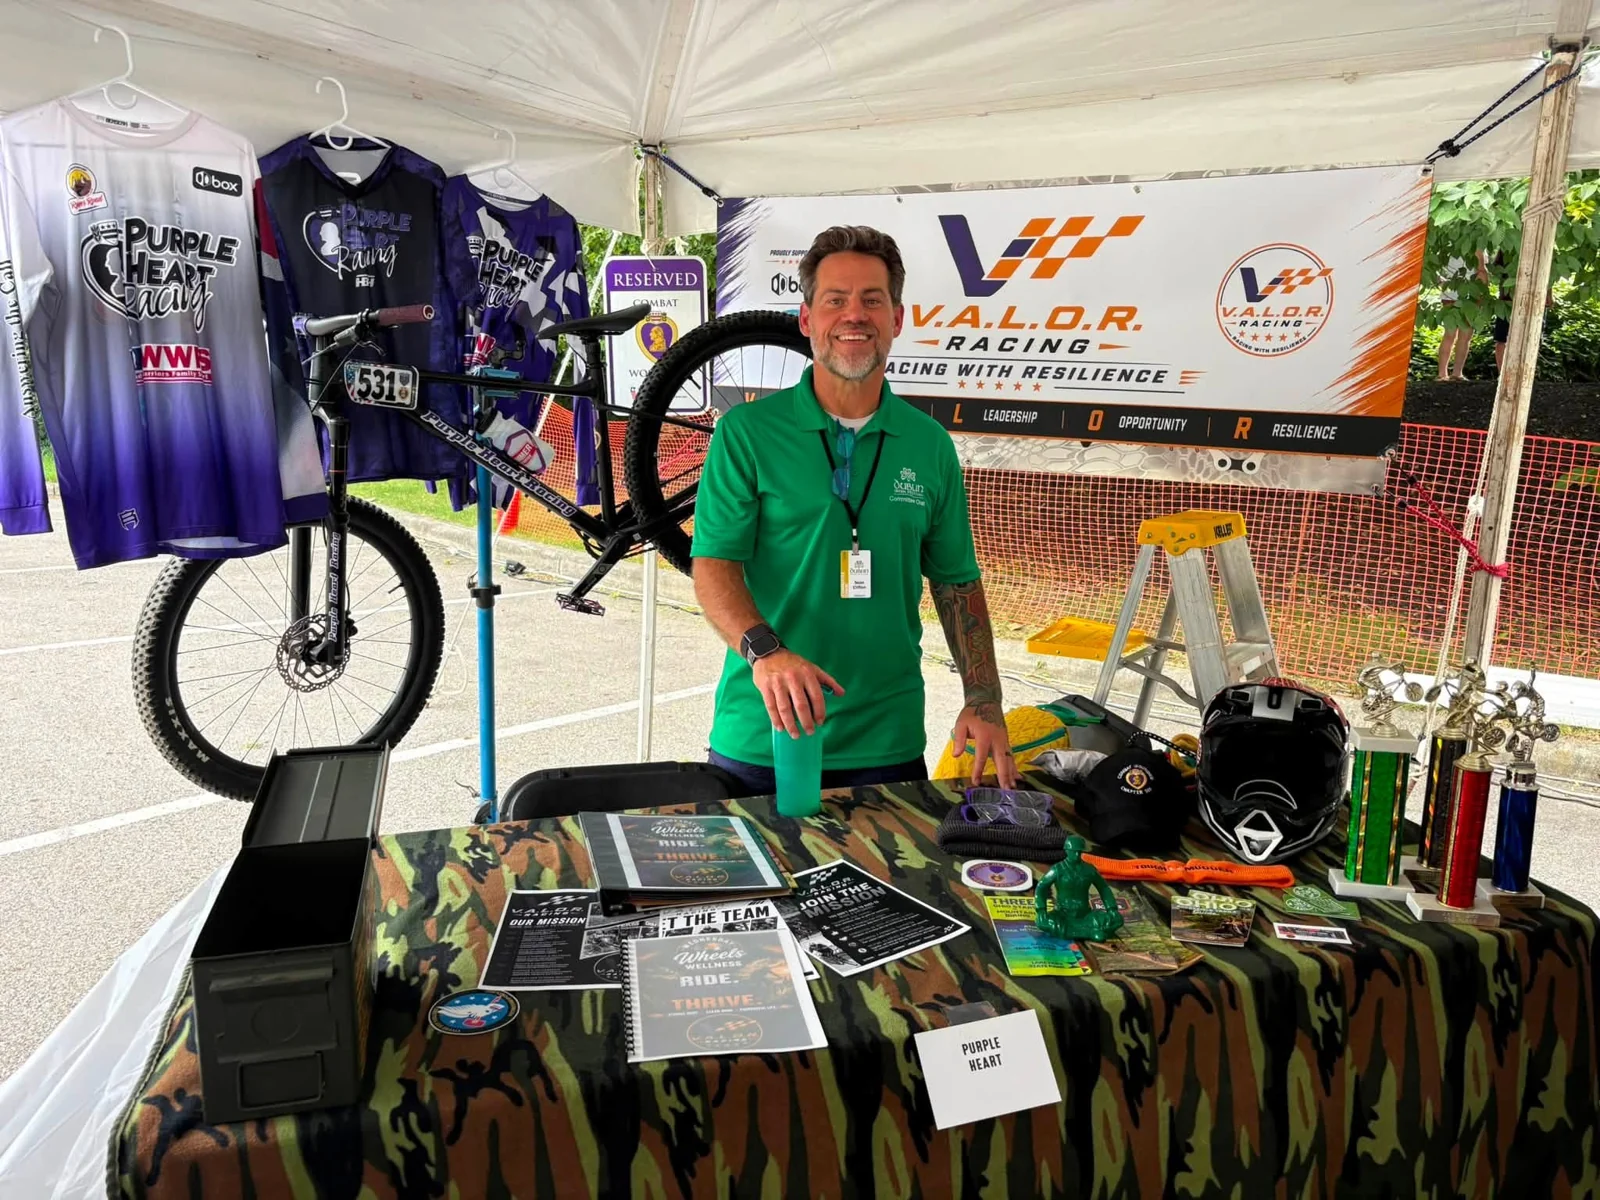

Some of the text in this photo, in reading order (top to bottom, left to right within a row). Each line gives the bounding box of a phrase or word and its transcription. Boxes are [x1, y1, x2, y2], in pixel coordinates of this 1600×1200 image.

[211, 175, 239, 192] box
[124, 217, 241, 265] PURPLE
[126, 251, 216, 289] HEART
[613, 272, 698, 287] RESERVED
[633, 299, 678, 307] COMBAT
[1222, 306, 1325, 318] V.A.L.O.R.
[912, 304, 1144, 332] V.A.L.O.R.
[1239, 320, 1303, 328] RACING
[946, 336, 1091, 355] RACING
[885, 361, 1169, 385] ACING WITH RESILIENCE
[357, 367, 396, 401] 531
[952, 403, 963, 424] L
[983, 408, 1038, 424] LEADERSHIP
[1087, 409, 1104, 431] O
[1118, 415, 1188, 432] OPPORTUNITY
[1233, 416, 1252, 440] R
[1271, 423, 1338, 440] RESILIENCE
[420, 410, 577, 516] Purple Heart Racing
[330, 531, 341, 570] Racing
[165, 696, 210, 763] MAXXIS
[650, 826, 706, 835] Wheels
[658, 839, 705, 848] RIDE.
[654, 852, 726, 861] THRIVE.
[800, 893, 836, 911] JOIN
[838, 882, 872, 896] THE
[804, 886, 887, 919] MISSION
[509, 917, 588, 926] OUR MISSION
[683, 911, 717, 927] THE
[721, 905, 770, 923] TEAM
[673, 947, 747, 965] Wheels
[684, 960, 742, 970] WELLNESS
[680, 973, 740, 987] RIDE.
[671, 993, 763, 1011] THRIVE.
[961, 1037, 1001, 1056] PURPLE
[968, 1053, 1003, 1072] HEART
